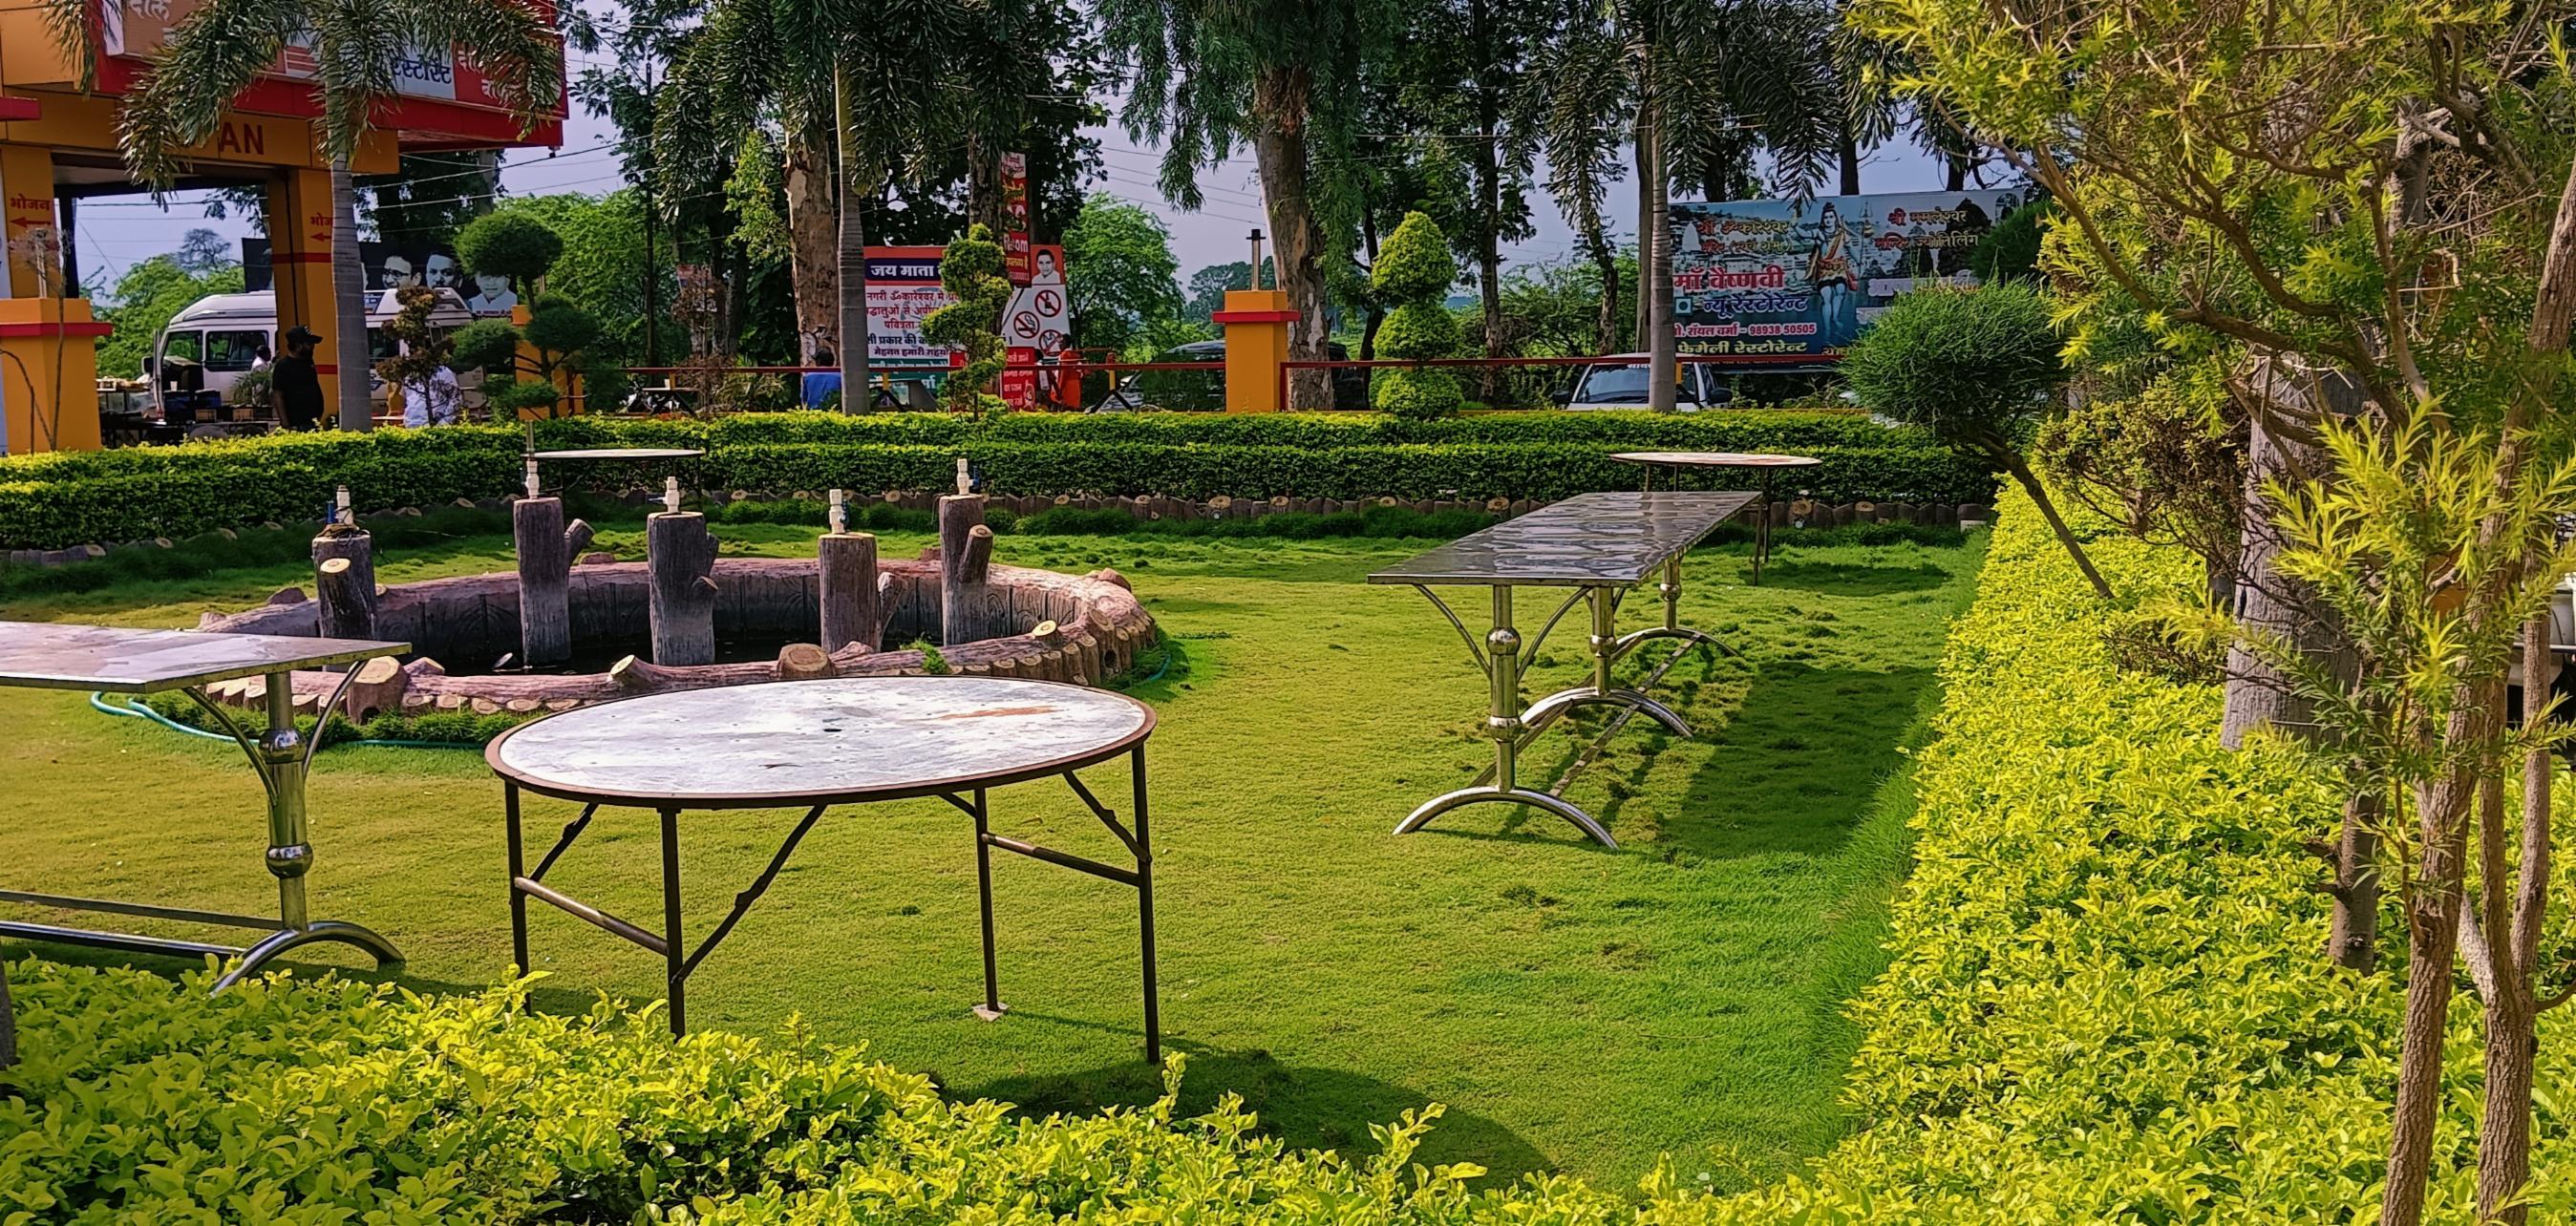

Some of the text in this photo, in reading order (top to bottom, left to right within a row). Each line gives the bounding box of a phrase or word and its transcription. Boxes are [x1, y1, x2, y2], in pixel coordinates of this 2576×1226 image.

[11, 193, 51, 211] भोजन
[1887, 207, 1906, 226] श्री
[870, 265, 897, 277] जय
[900, 265, 934, 277] माता
[1710, 264, 1785, 289] वैष्णवी
[866, 290, 886, 302] नगरी
[884, 318, 914, 329] पवित्रता
[1749, 325, 1780, 336] 98938
[1782, 324, 1817, 335] 50505
[879, 336, 903, 345] प्रकार
[905, 333, 917, 345] की
